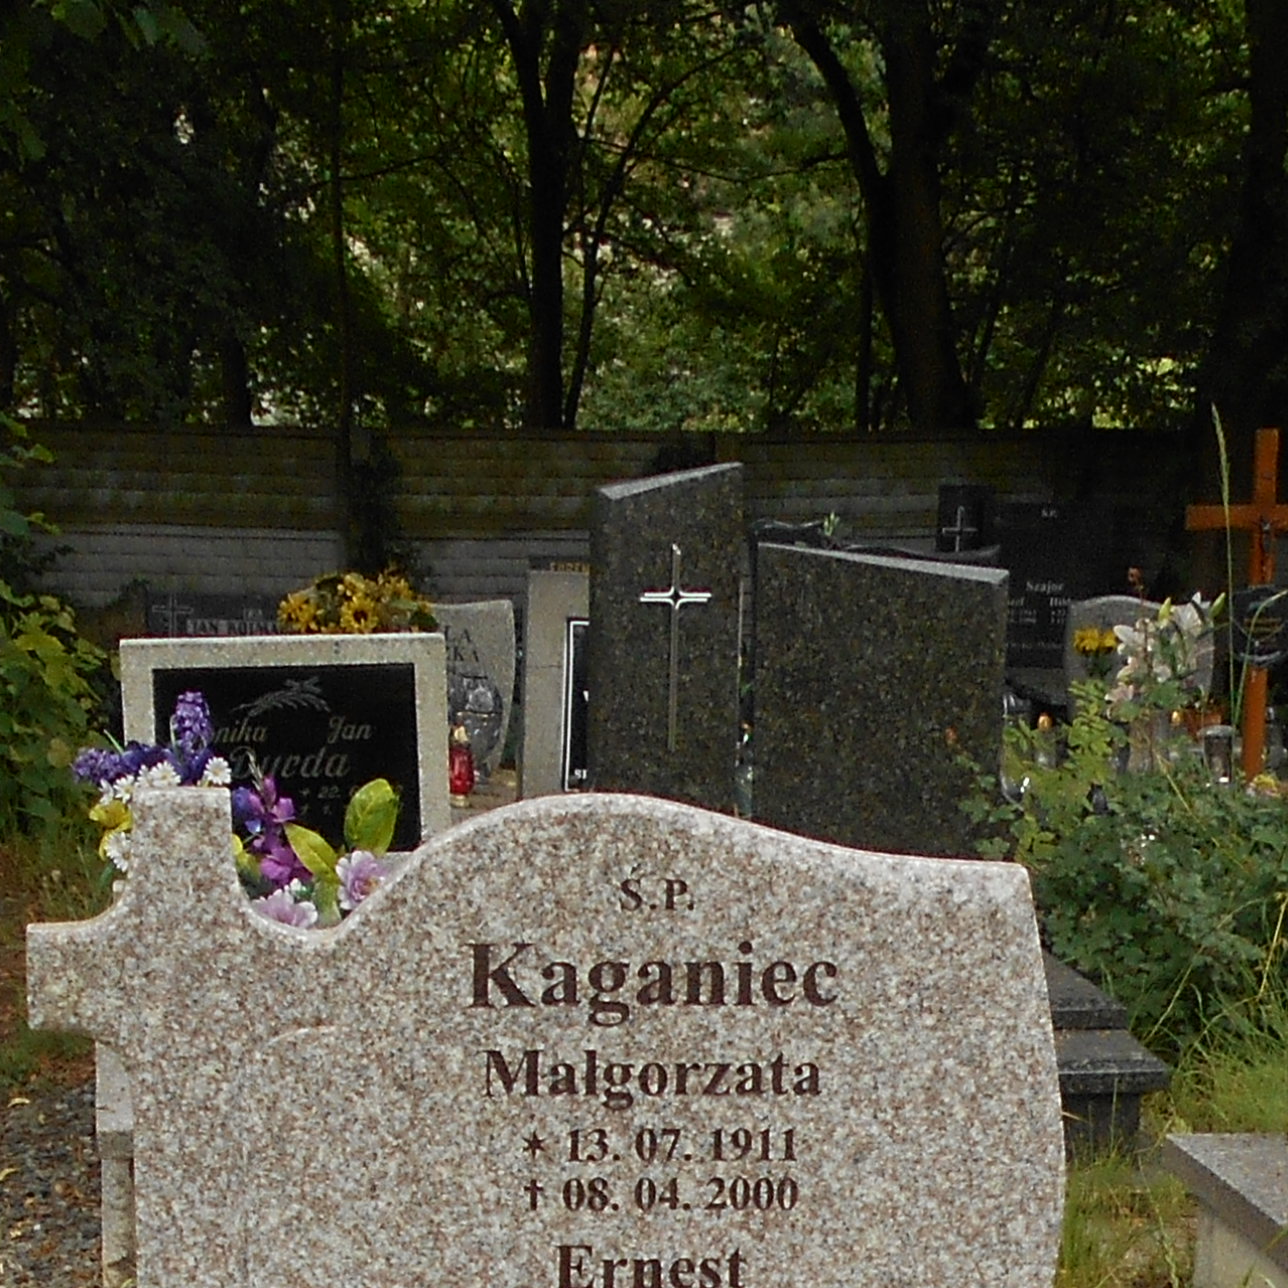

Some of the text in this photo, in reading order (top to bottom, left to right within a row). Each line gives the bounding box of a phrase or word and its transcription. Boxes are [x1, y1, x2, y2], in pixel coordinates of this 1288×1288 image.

[213, 716, 373, 745] nika Jan
[466, 942, 839, 1027] Kaganiec
[566, 1126, 798, 1162] 13. 07. 1911
[562, 1176, 800, 1212] 08. 04. 2000
